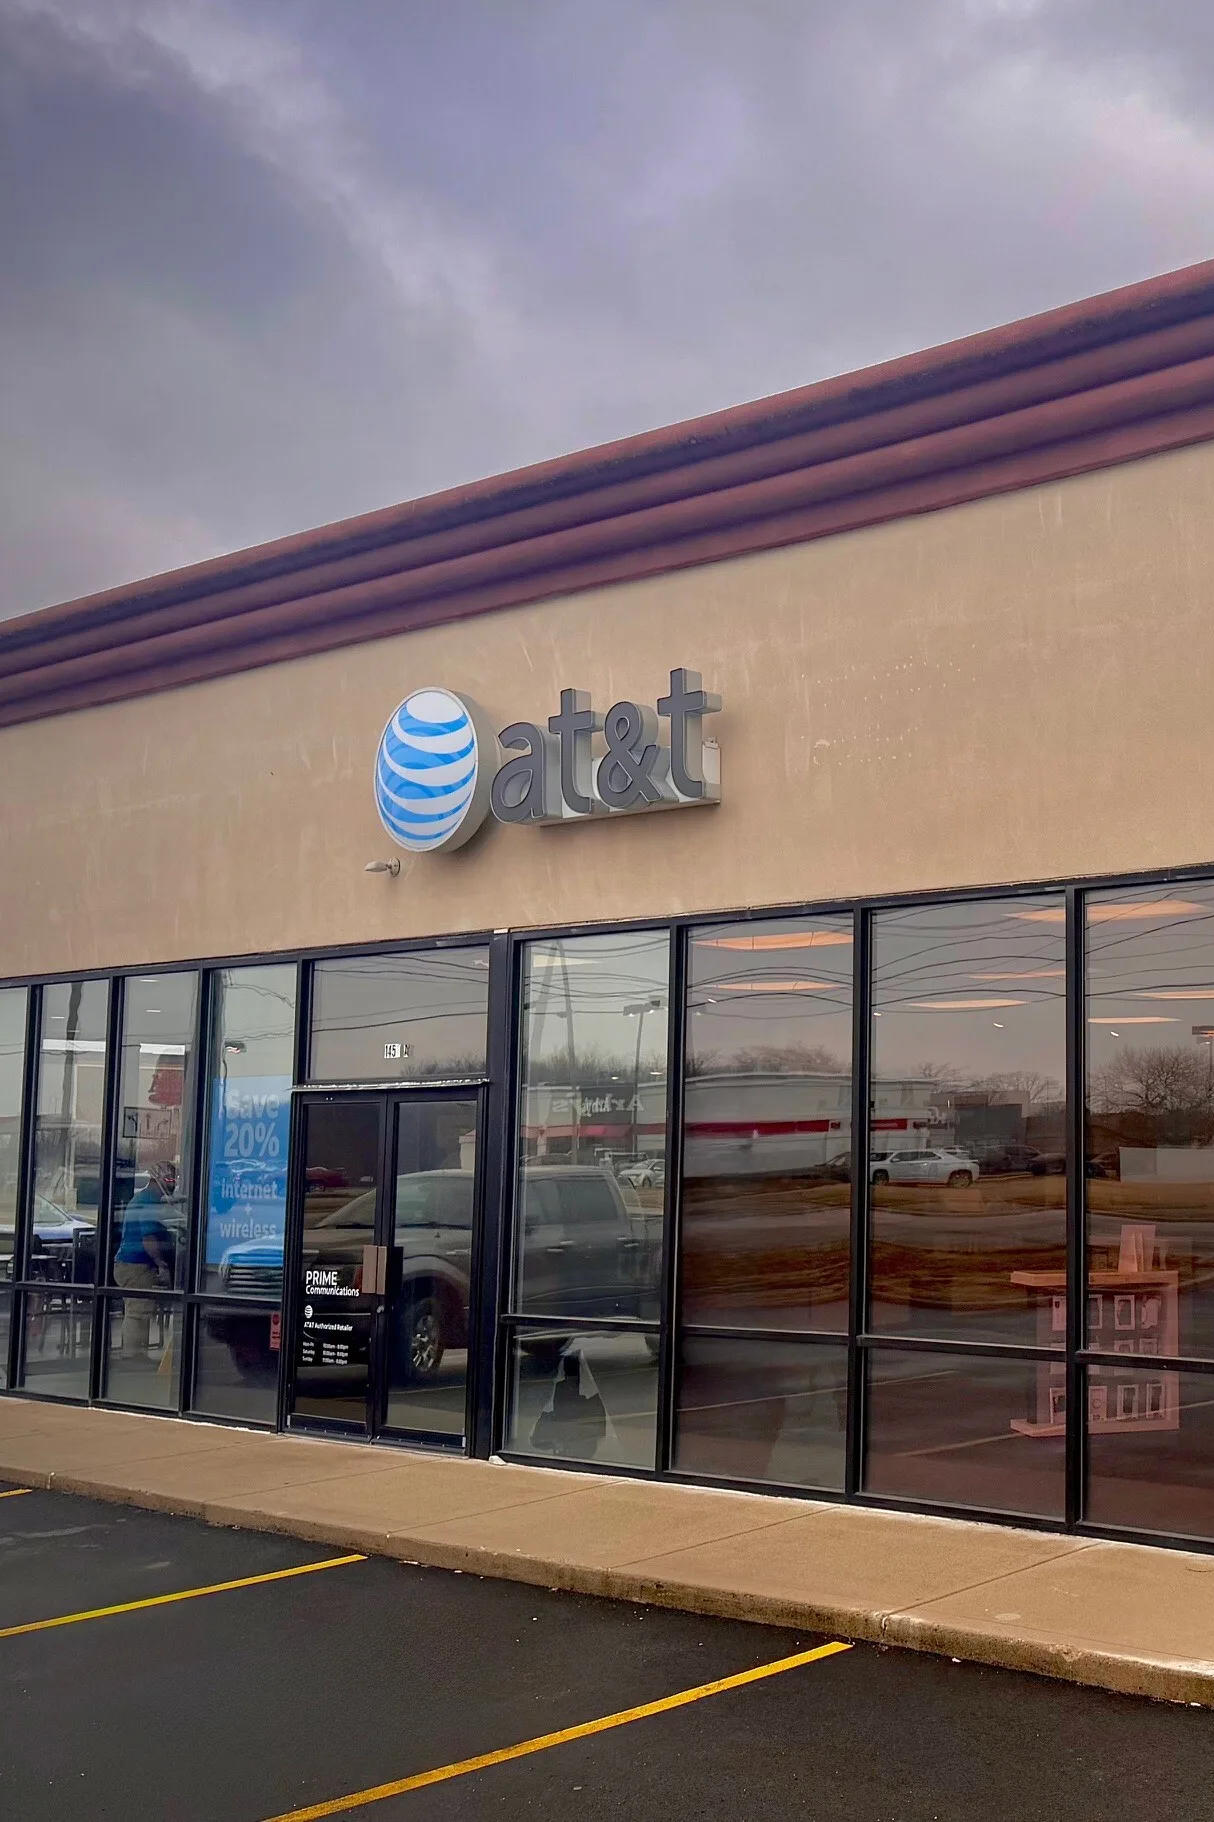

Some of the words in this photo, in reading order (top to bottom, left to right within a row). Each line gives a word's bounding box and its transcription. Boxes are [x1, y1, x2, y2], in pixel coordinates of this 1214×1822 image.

[490, 667, 718, 824] at&t
[225, 1089, 279, 1119] Save
[224, 1122, 280, 1157] 20%
[222, 1178, 278, 1199] internet
[220, 1218, 277, 1238] wireless
[305, 1270, 338, 1286] PRIME
[305, 1285, 360, 1297] Communications
